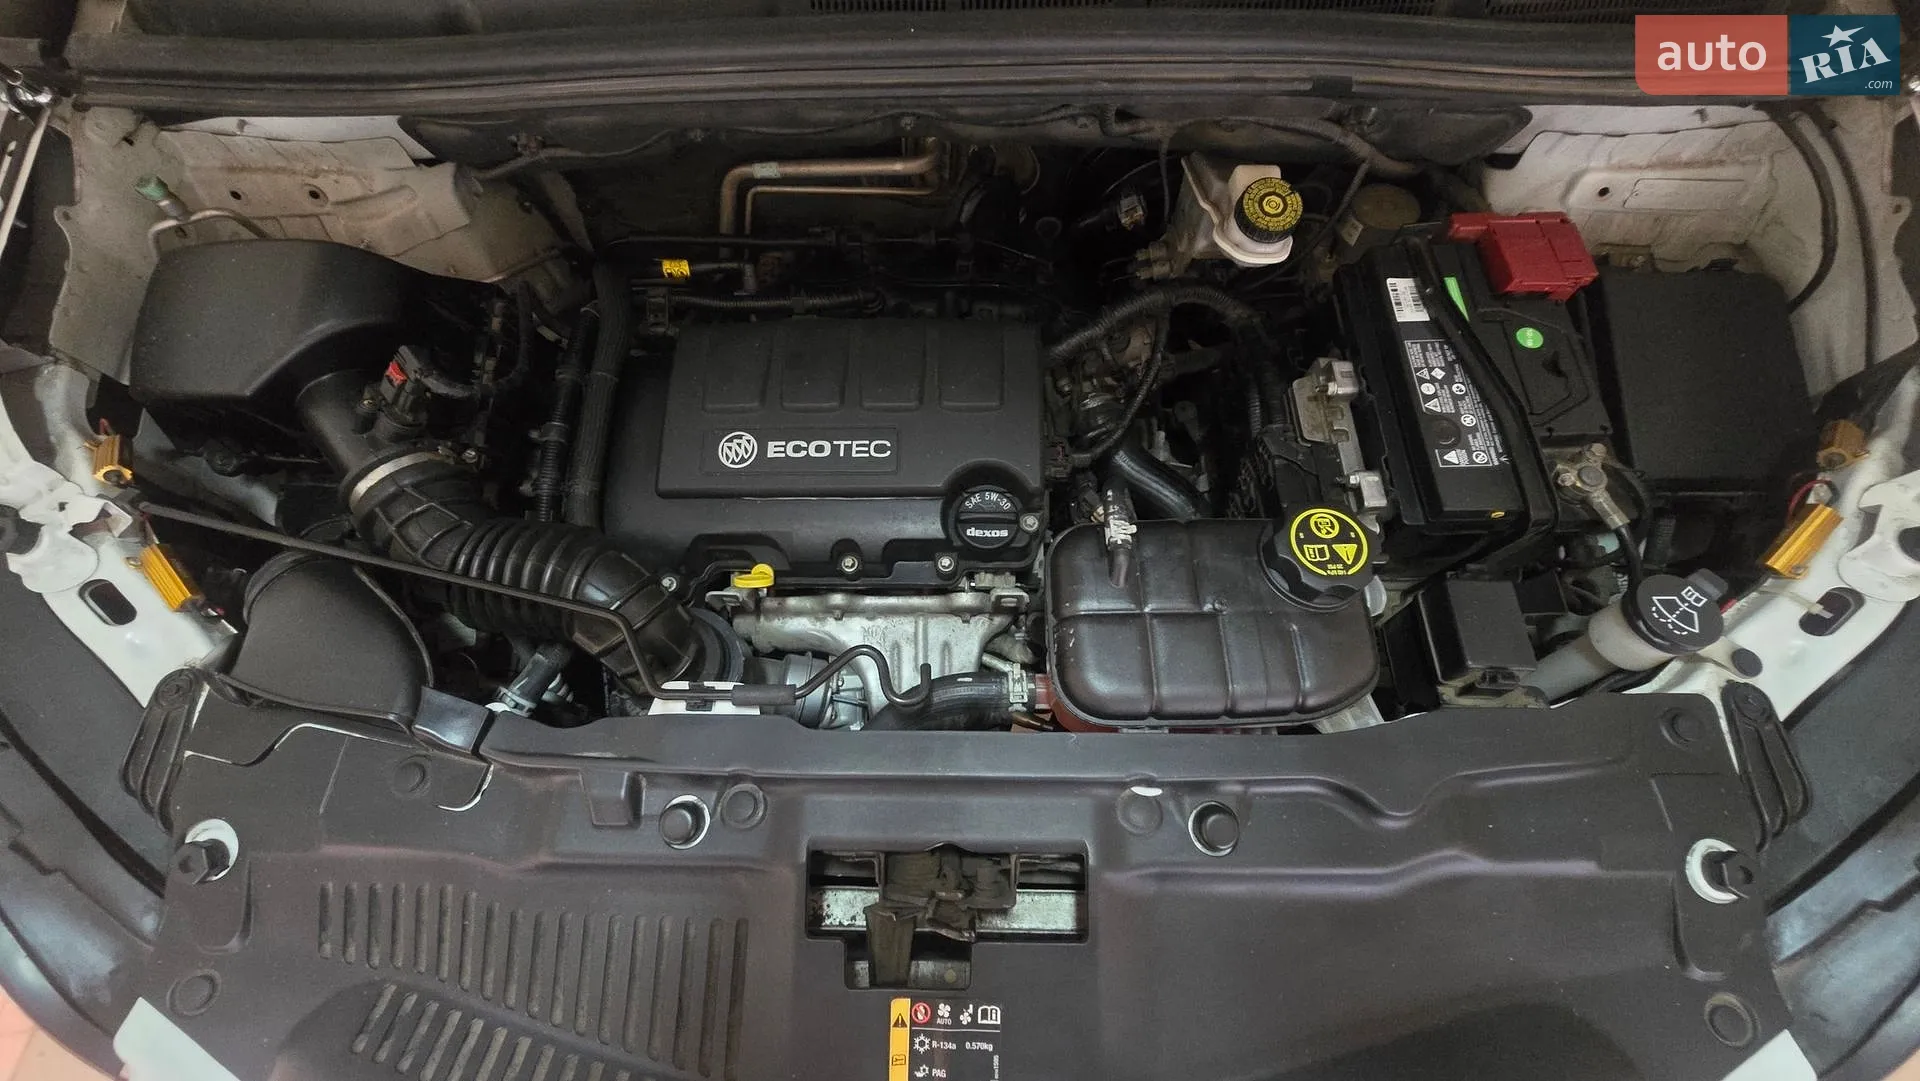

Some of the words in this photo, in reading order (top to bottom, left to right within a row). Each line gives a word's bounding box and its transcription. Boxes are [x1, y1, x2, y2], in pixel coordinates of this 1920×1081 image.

[767, 440, 892, 459] ECOTEC
[964, 492, 982, 509] SAE
[984, 491, 1012, 510] 5W-30
[966, 527, 1009, 537] dexos
[931, 1041, 957, 1050] R-134a
[965, 1041, 993, 1052] 0.570kg
[931, 1068, 947, 1078] PAG
